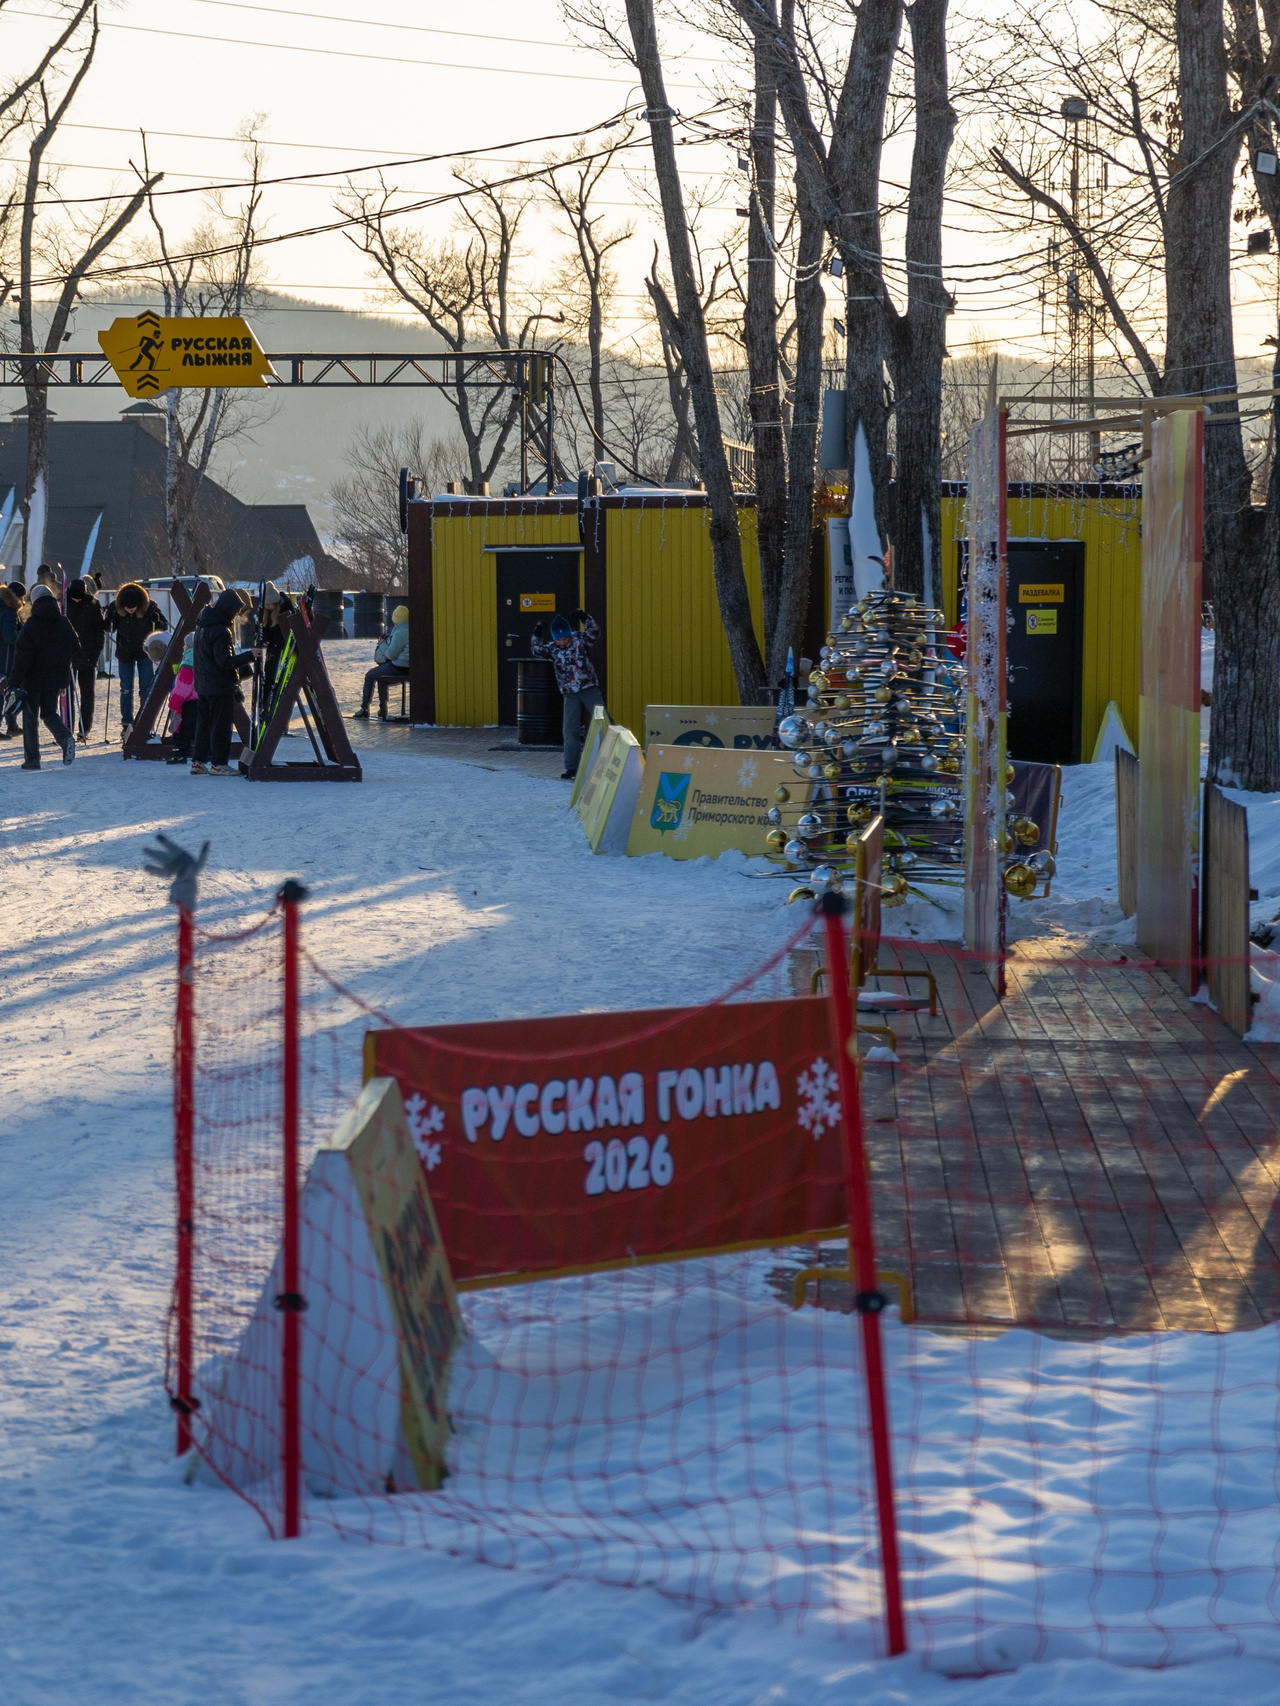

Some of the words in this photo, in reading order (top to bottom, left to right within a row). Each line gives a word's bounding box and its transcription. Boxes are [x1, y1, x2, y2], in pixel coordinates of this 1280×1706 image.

[171, 337, 252, 351] РУССКАЯ
[182, 352, 252, 366] ЛЫЖНЯ
[835, 575, 854, 584] РЕГИС
[1022, 589, 1061, 597] РАЗДЕВАЛКА
[692, 789, 768, 808] Правительство
[687, 807, 756, 827] Приморского
[461, 1071, 645, 1144] РУССКАЯ
[657, 1059, 782, 1123] ГОНКА
[583, 1133, 675, 1196] 2026
